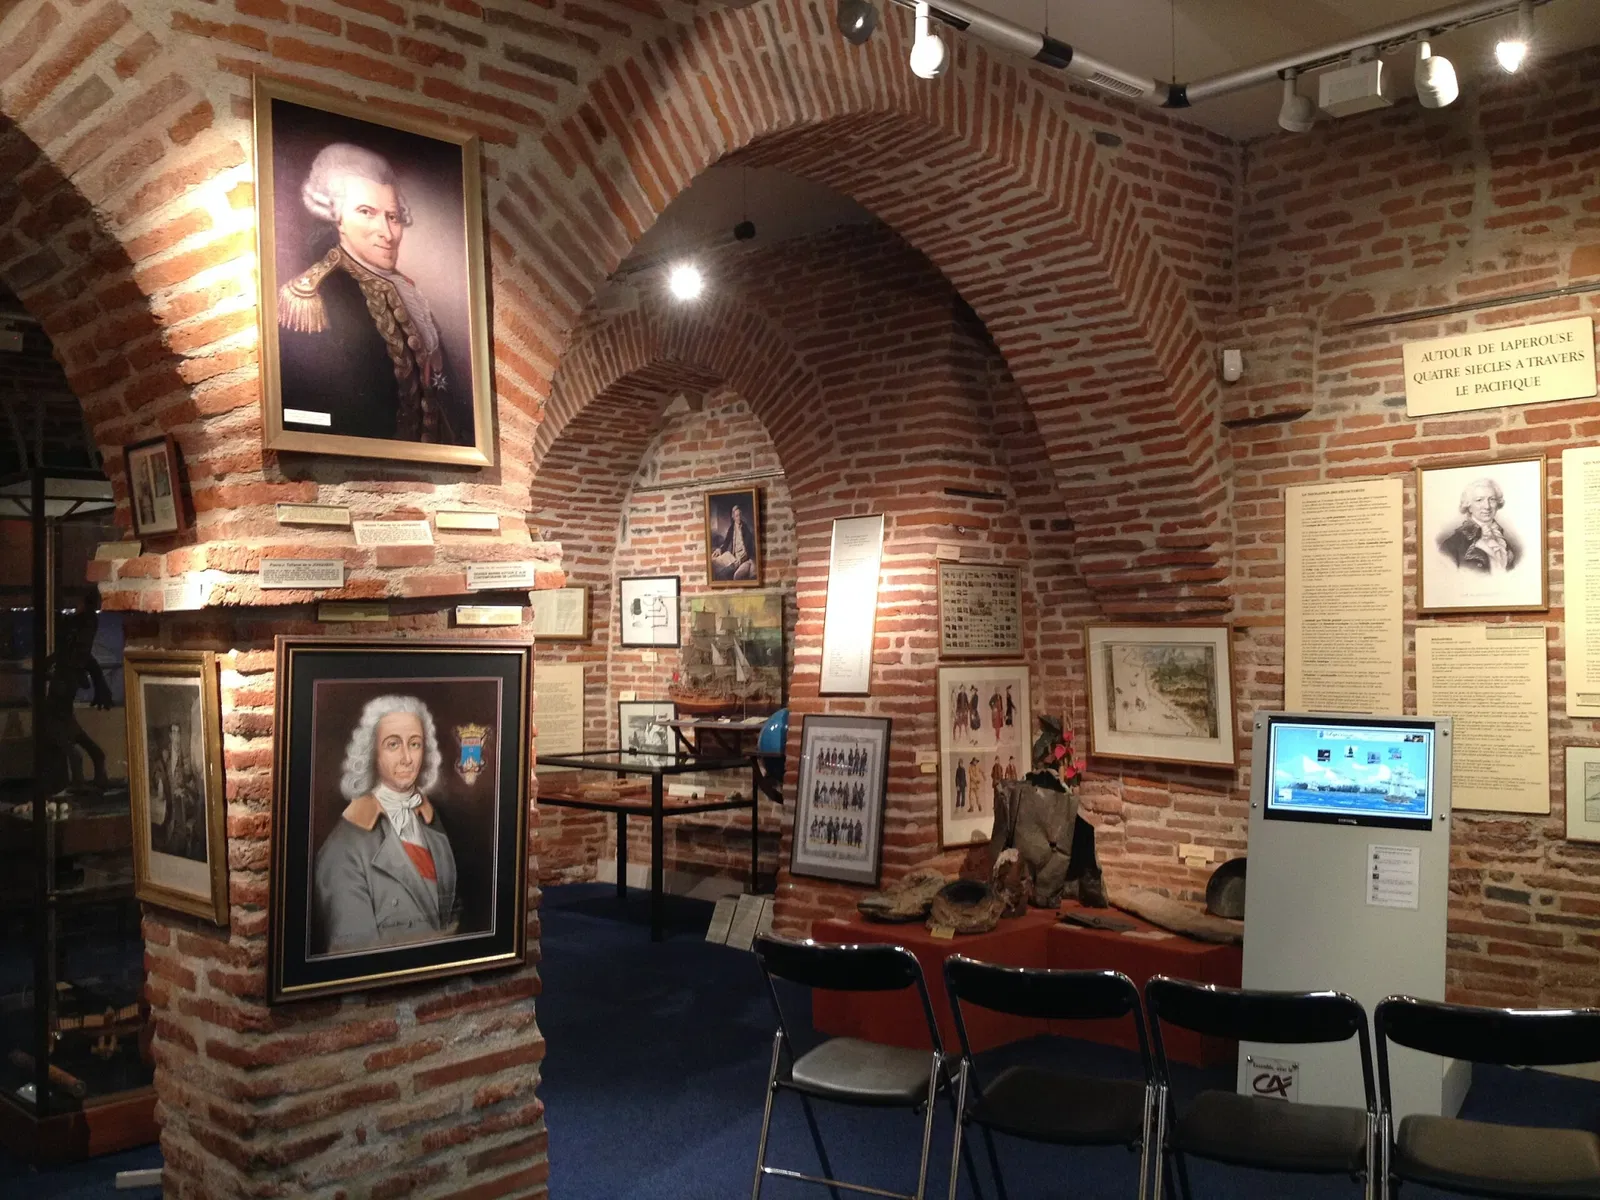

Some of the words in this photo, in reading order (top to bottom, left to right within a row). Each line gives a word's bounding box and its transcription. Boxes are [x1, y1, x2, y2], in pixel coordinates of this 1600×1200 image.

[1421, 346, 1472, 363] AUTOUR
[1478, 343, 1495, 355] DE
[1500, 331, 1574, 352] LAPEROUSE
[1413, 367, 1461, 385] QUATRE
[1465, 360, 1512, 376] SIECLES
[1515, 359, 1524, 369] A
[1525, 350, 1585, 368] TRAVERS
[1456, 385, 1469, 397] LE
[1475, 376, 1541, 394] PACIFIQUE
